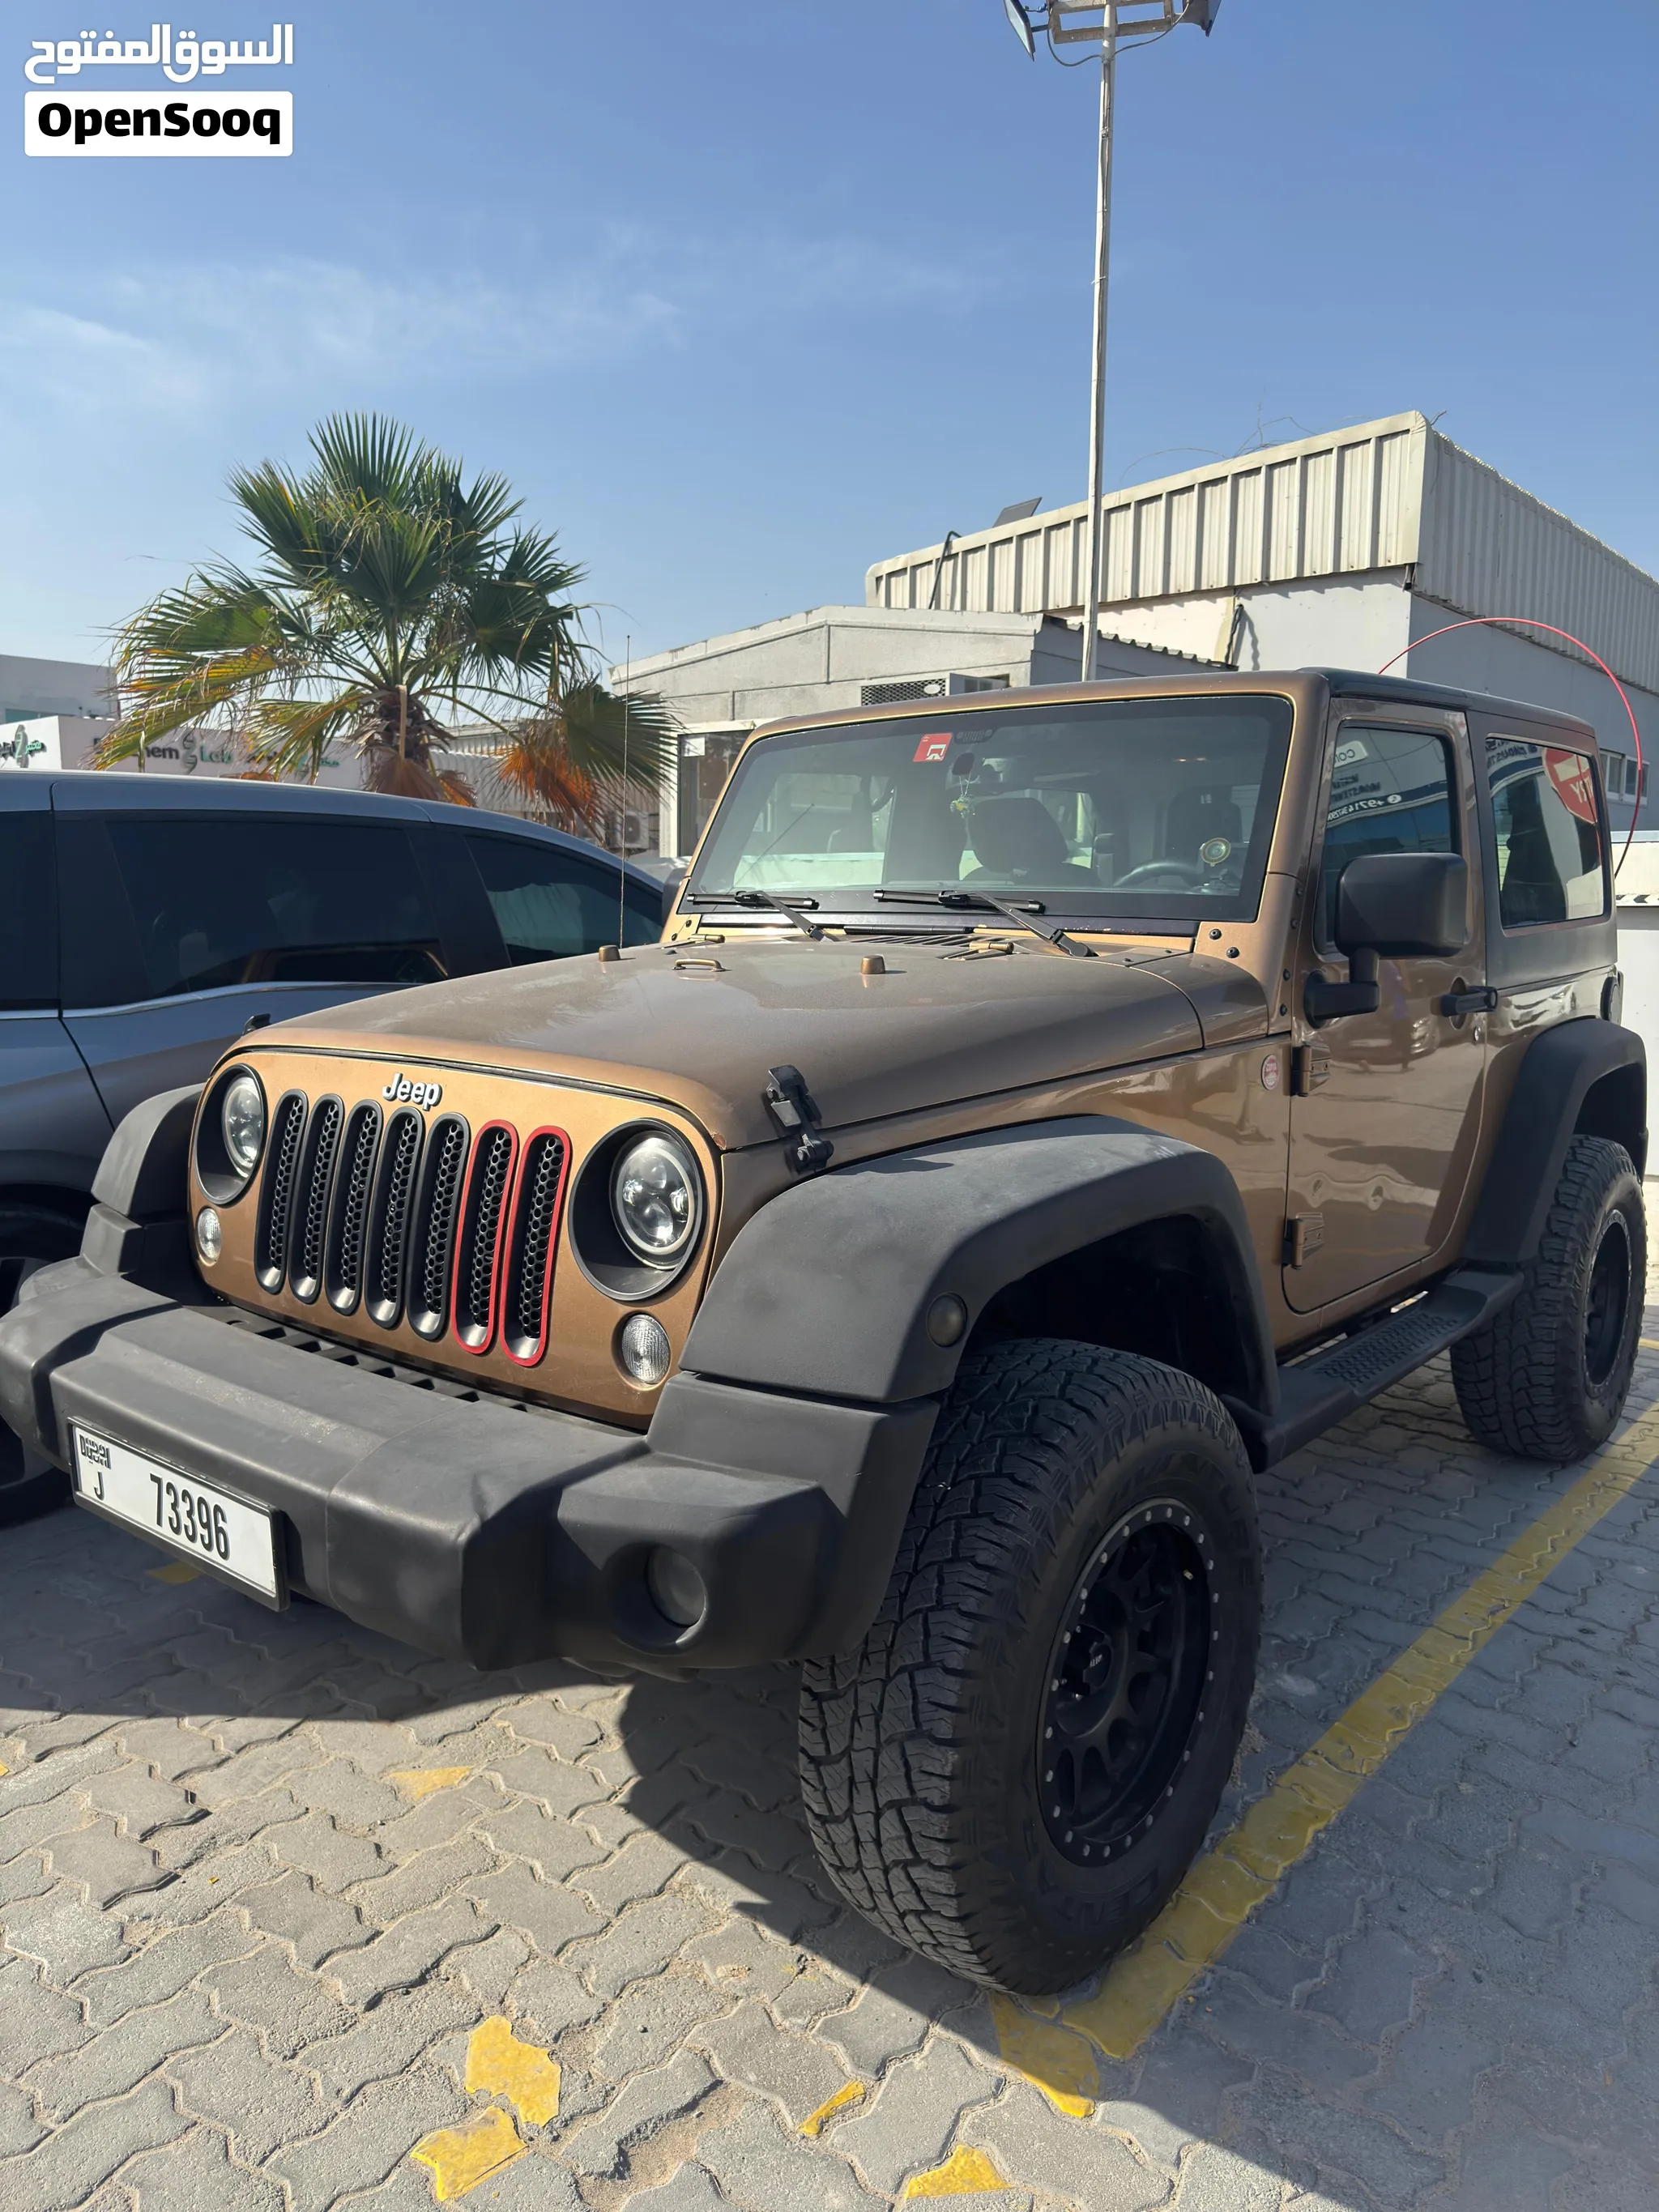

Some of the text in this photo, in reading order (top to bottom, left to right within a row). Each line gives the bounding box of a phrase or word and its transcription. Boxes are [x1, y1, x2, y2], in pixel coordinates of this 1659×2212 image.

[382, 1072, 443, 1112] Jeep
[93, 1471, 230, 1562] J 73396
